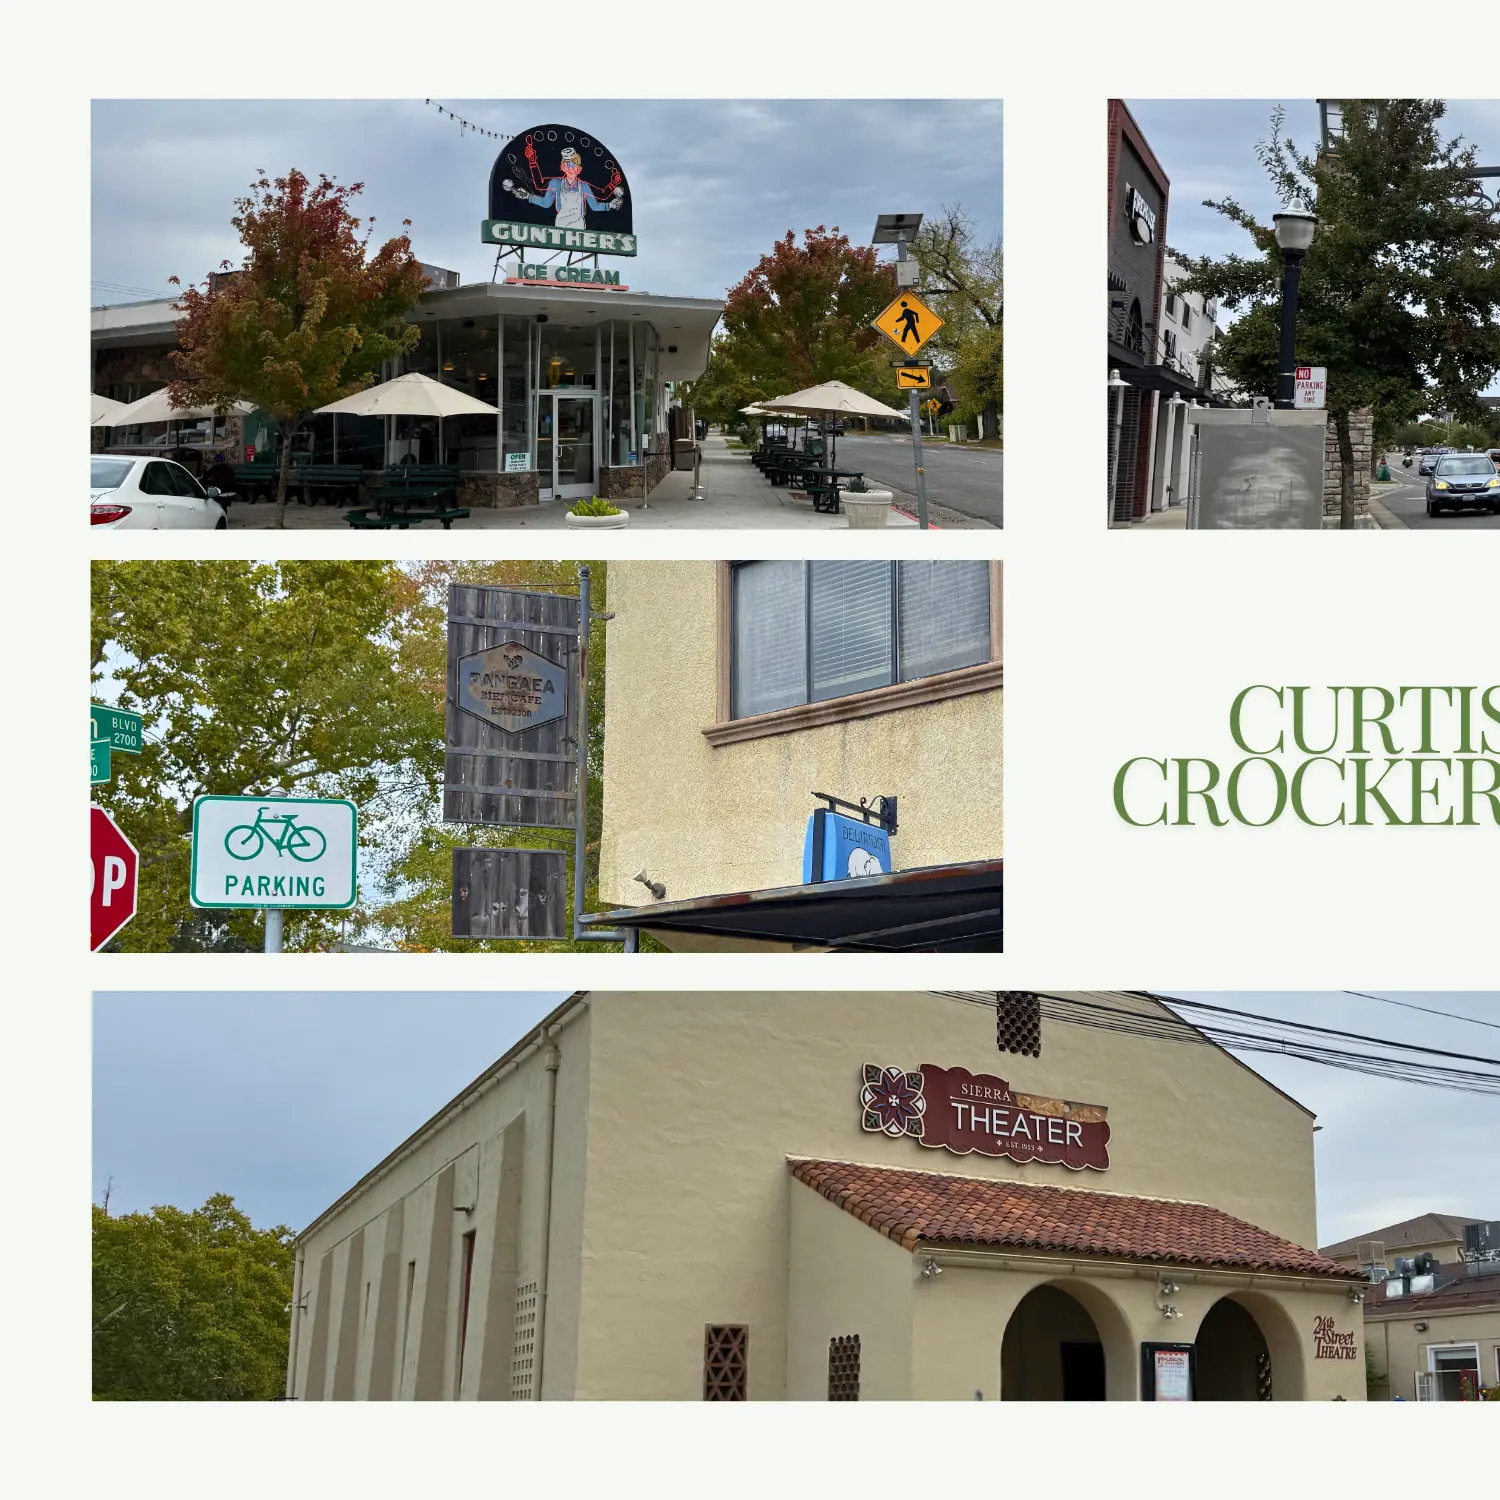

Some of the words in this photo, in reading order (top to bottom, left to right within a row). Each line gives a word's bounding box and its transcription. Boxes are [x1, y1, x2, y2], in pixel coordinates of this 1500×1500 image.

[492, 223, 635, 251] GUNTHER'S
[517, 263, 547, 281] ICE
[554, 268, 620, 286] CREAM
[1298, 369, 1310, 379] NO
[1296, 382, 1324, 390] PARKING
[469, 671, 556, 695] PANGAEA
[510, 695, 542, 705] CAFE
[112, 717, 137, 732] BLVD
[114, 732, 137, 747] 2700
[224, 874, 325, 897] PARKING
[961, 1083, 1012, 1102] SIERRA
[951, 1102, 1084, 1148] THEATER
[1313, 1315, 1335, 1336] 24th
[1314, 1335, 1358, 1360] THEATRE
[1325, 1329, 1355, 1346] Street
